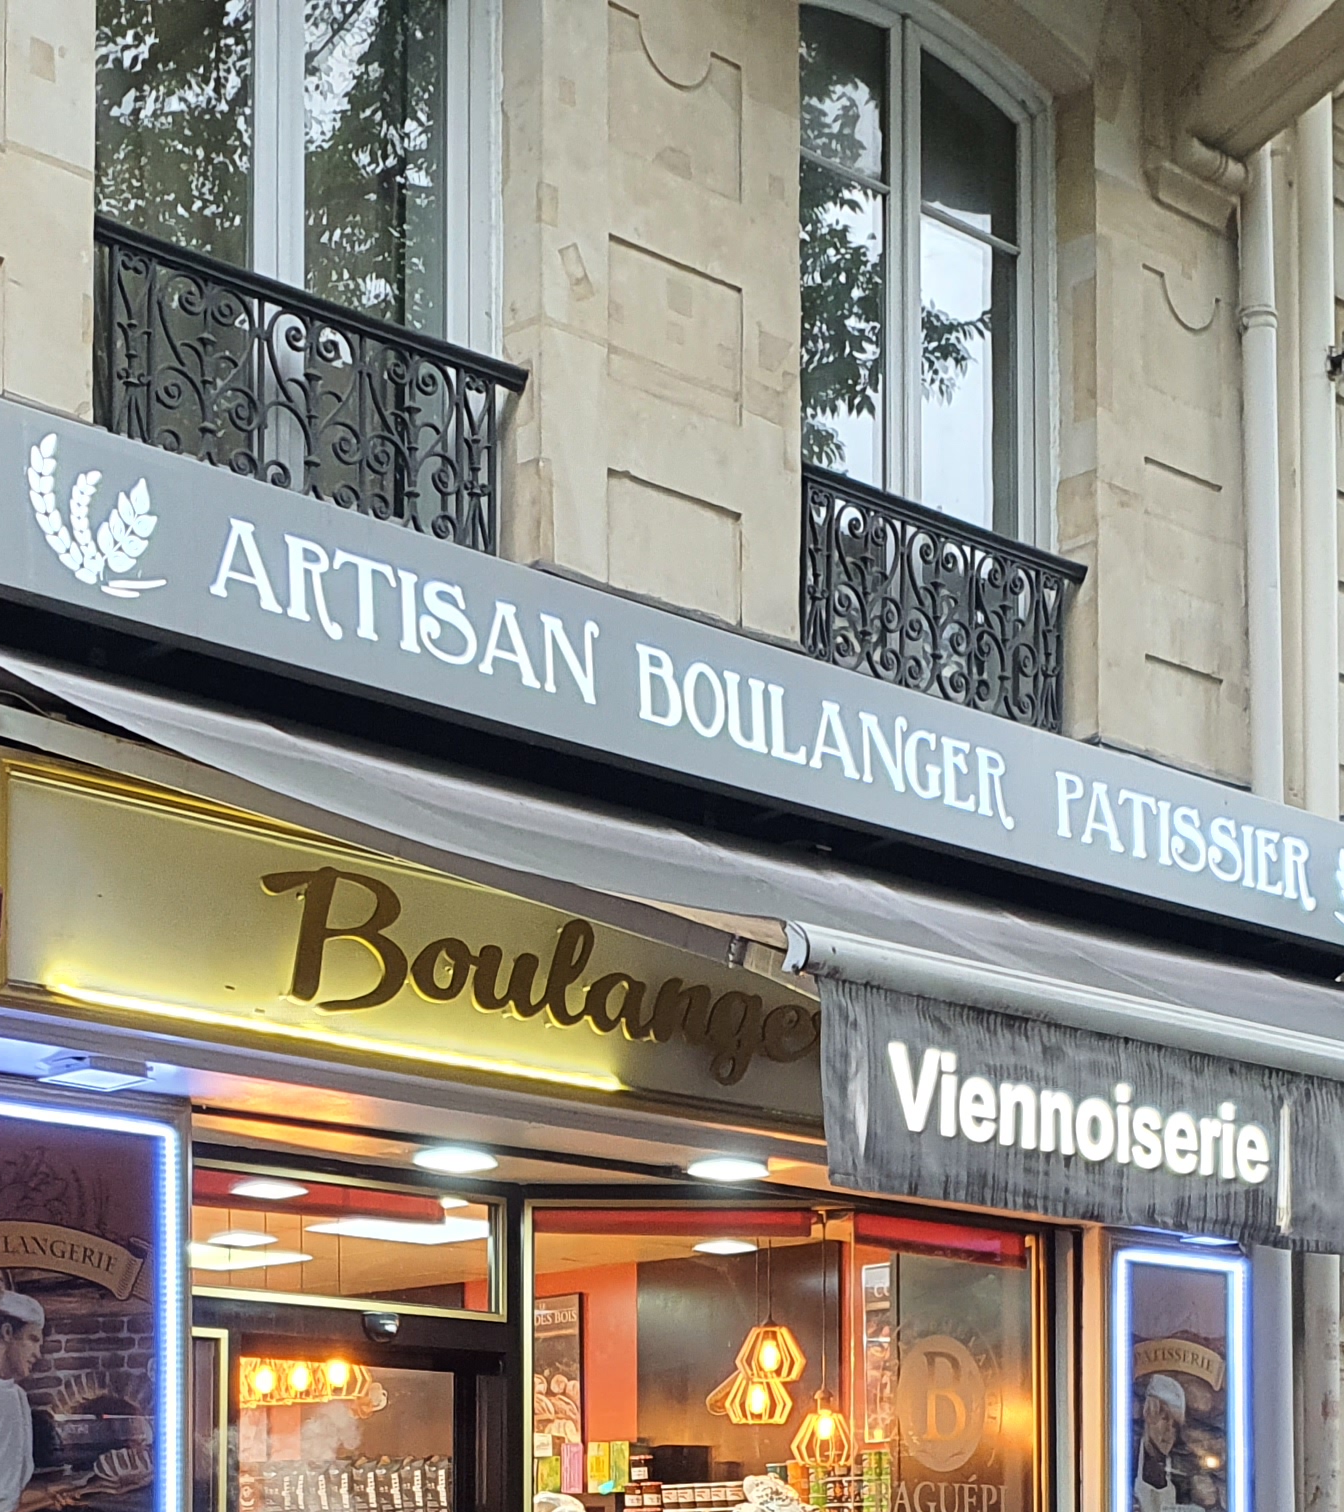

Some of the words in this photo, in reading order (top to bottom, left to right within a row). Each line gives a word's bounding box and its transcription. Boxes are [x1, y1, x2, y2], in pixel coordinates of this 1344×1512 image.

[209, 517, 601, 707] ARTISAN
[636, 642, 1016, 831] BOULANGER
[1054, 767, 1316, 913] PATISSIER
[259, 867, 821, 1087] Boulange
[888, 1040, 1271, 1185] Viennoiserie
